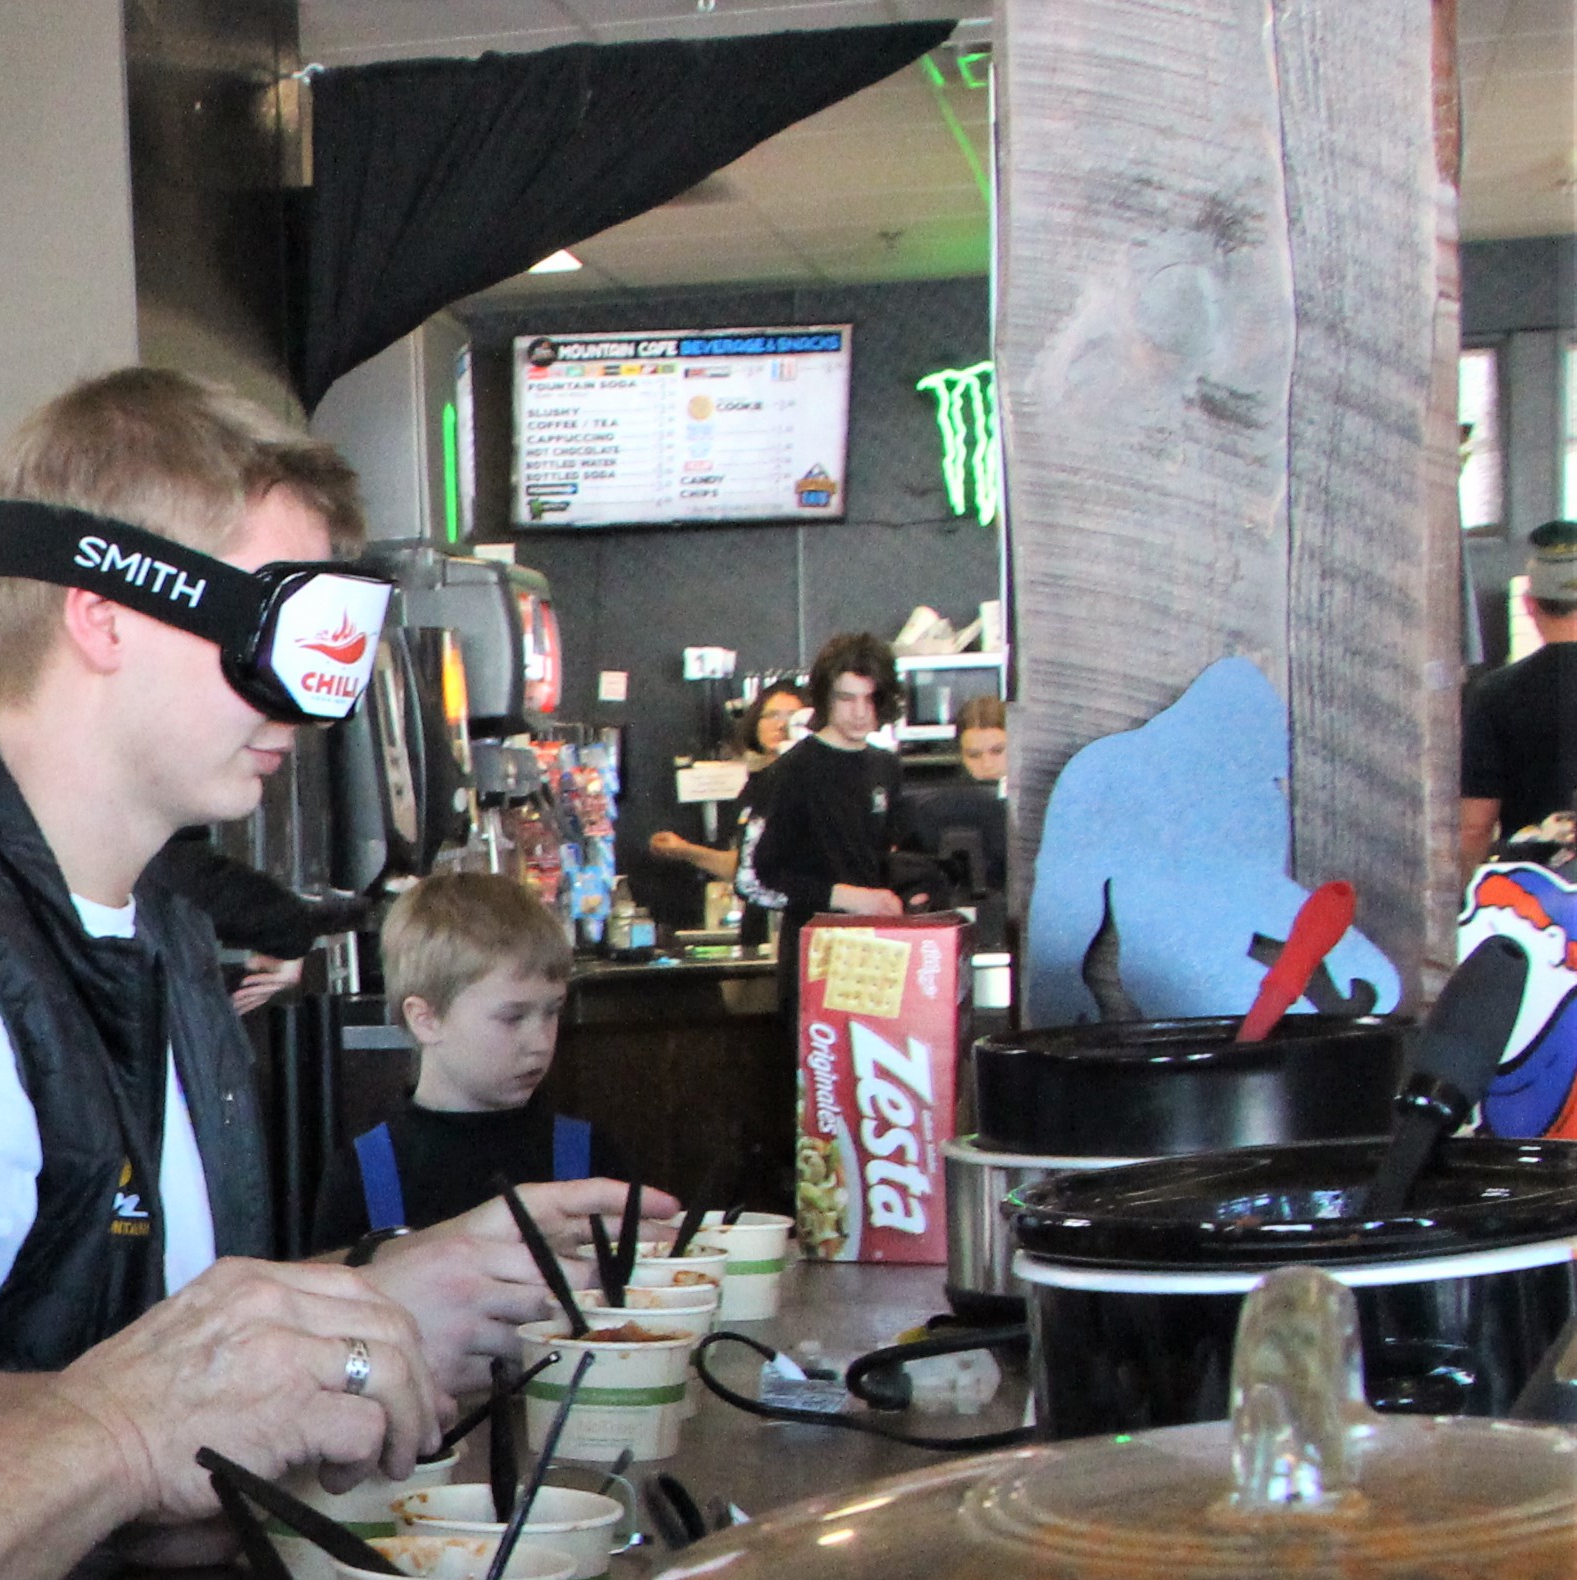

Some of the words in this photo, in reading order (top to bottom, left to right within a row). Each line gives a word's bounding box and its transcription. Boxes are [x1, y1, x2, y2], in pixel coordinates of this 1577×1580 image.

[557, 341, 635, 361] MOUNTAIN
[637, 339, 679, 358] CAFE
[527, 381, 595, 391] FOUNTAIN
[600, 379, 637, 389] SODA
[527, 421, 578, 430] COFFEE
[593, 418, 620, 428] TEA
[74, 535, 207, 609] SMITH
[301, 671, 360, 698] CHILI
[807, 1021, 839, 1136] Originales
[848, 1019, 935, 1236] Zesta
